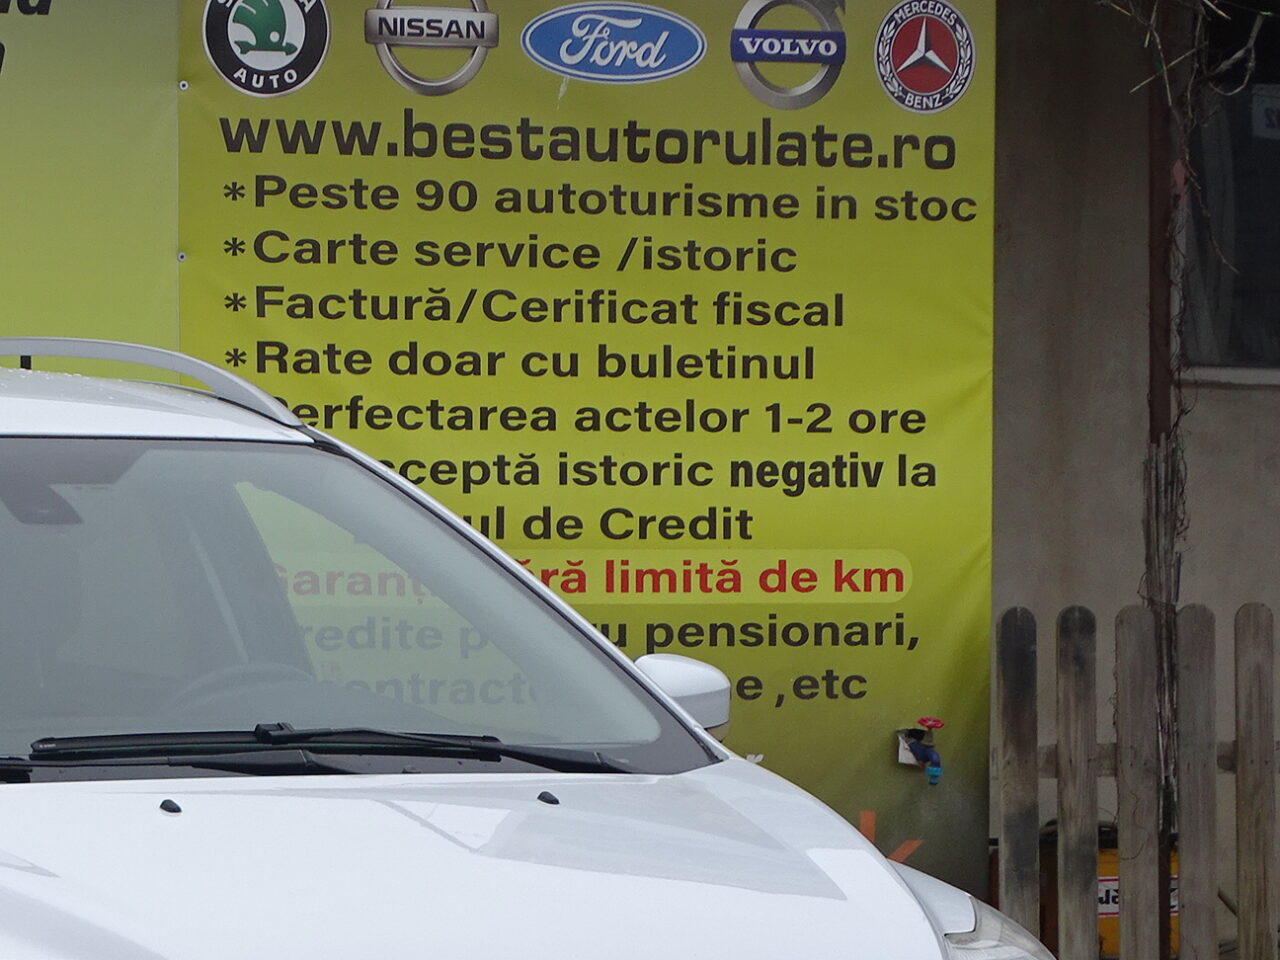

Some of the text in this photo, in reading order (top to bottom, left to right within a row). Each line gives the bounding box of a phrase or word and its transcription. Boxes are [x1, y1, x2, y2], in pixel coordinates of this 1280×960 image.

[377, 16, 486, 40] NISSAN
[894, 0, 957, 26] MERCEDES
[559, 13, 670, 69] Ford
[739, 37, 838, 57] VOLVO
[232, 66, 298, 89] AUTO
[904, 93, 944, 110] BENZ
[220, 107, 957, 170] www.bestautorulate.ro
[415, 179, 478, 212] 90
[494, 182, 800, 219] autoturisme
[815, 185, 858, 220] in
[874, 190, 978, 222] stoc
[414, 234, 601, 270] service
[713, 291, 845, 327] fiscal
[388, 341, 506, 377] doar
[521, 350, 580, 378] cu
[597, 344, 815, 380] buletinul
[574, 398, 750, 433] actelor
[765, 402, 833, 434] 1-2
[848, 406, 927, 434] ore
[378, 451, 937, 497] ceptă istoric negativ la
[522, 505, 584, 540] de
[599, 506, 754, 541] Credit
[605, 559, 742, 594] limită
[758, 559, 818, 593] de
[833, 559, 905, 593] km
[646, 612, 919, 654] pensionari,
